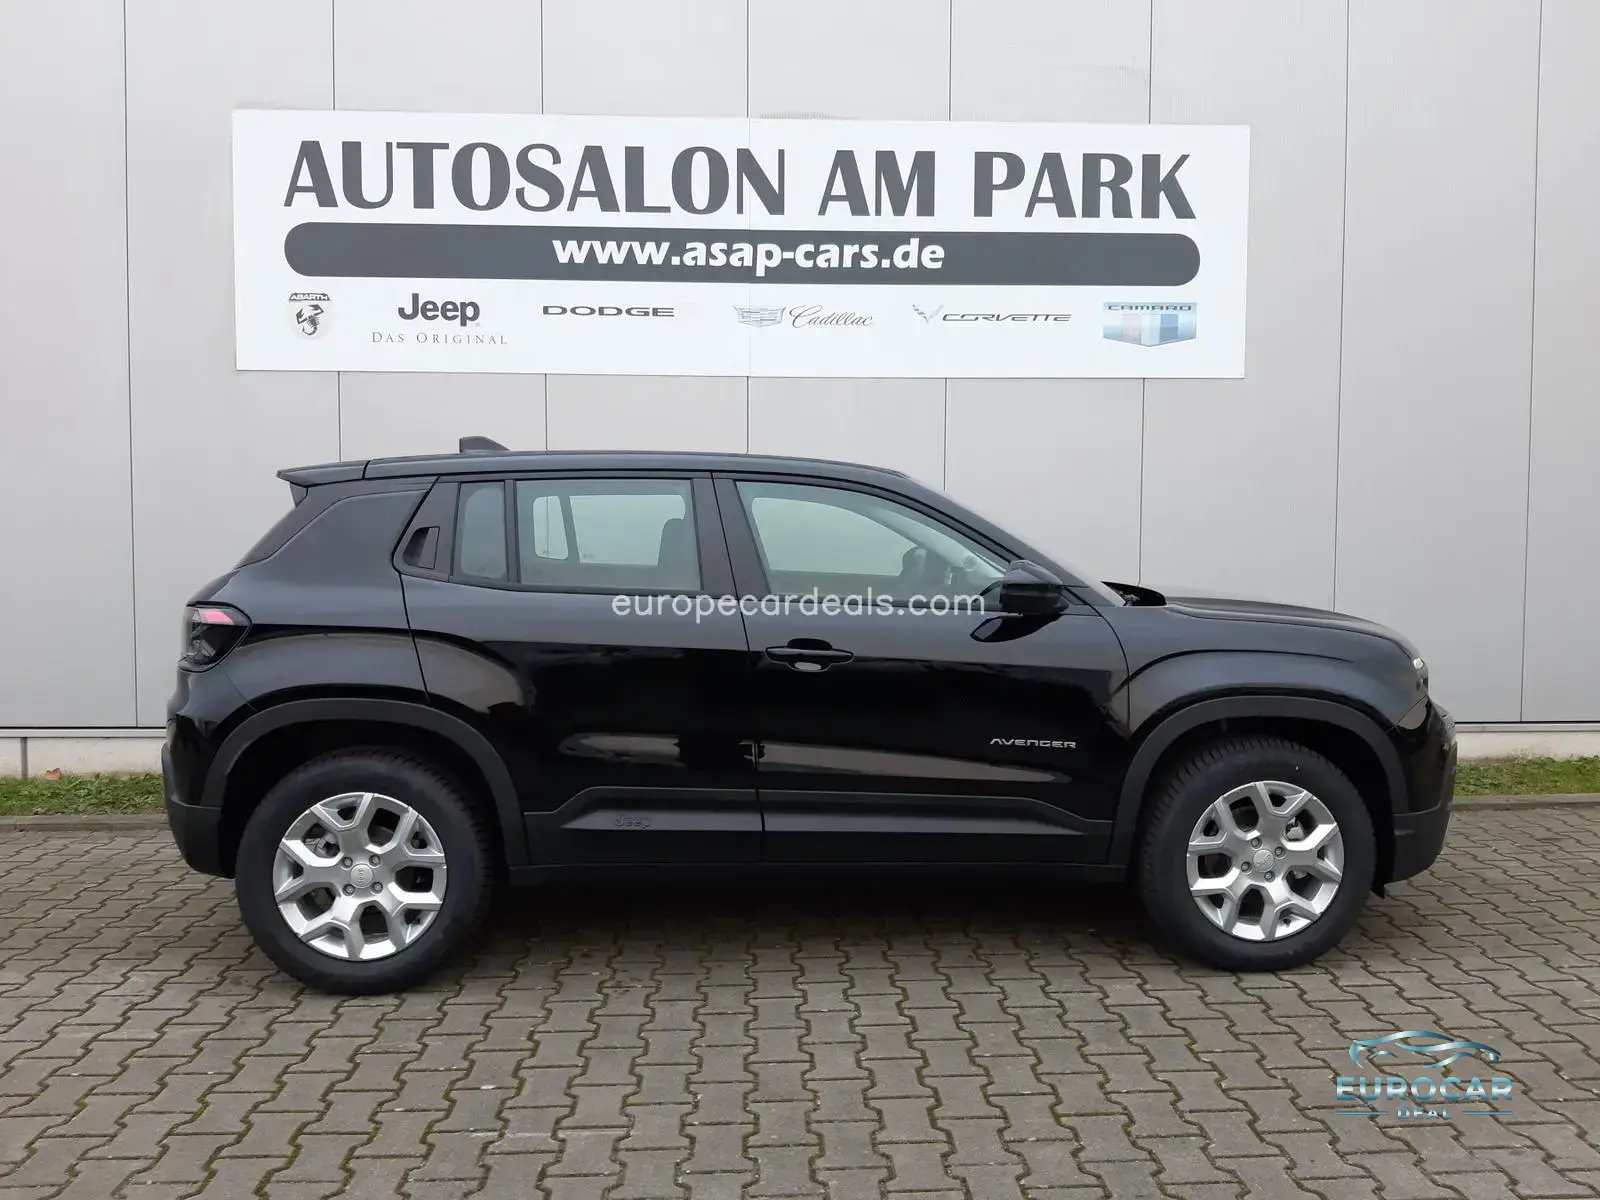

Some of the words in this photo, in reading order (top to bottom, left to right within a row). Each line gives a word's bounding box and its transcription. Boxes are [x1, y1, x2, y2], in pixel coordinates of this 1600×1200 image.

[283, 139, 785, 216] AUTOSALON
[818, 149, 936, 217] AM
[973, 151, 1197, 219] PARK
[552, 237, 945, 277] www.asap-cars.de
[397, 292, 481, 327] Jeep
[542, 305, 675, 318] DODGE
[1107, 304, 1193, 312] CAMARO
[788, 304, 874, 329] Cadillac
[942, 313, 1072, 323] CORVETTE
[371, 331, 406, 344] DAS
[416, 331, 509, 346] ORIGINAL
[989, 738, 1077, 749] AVENGER
